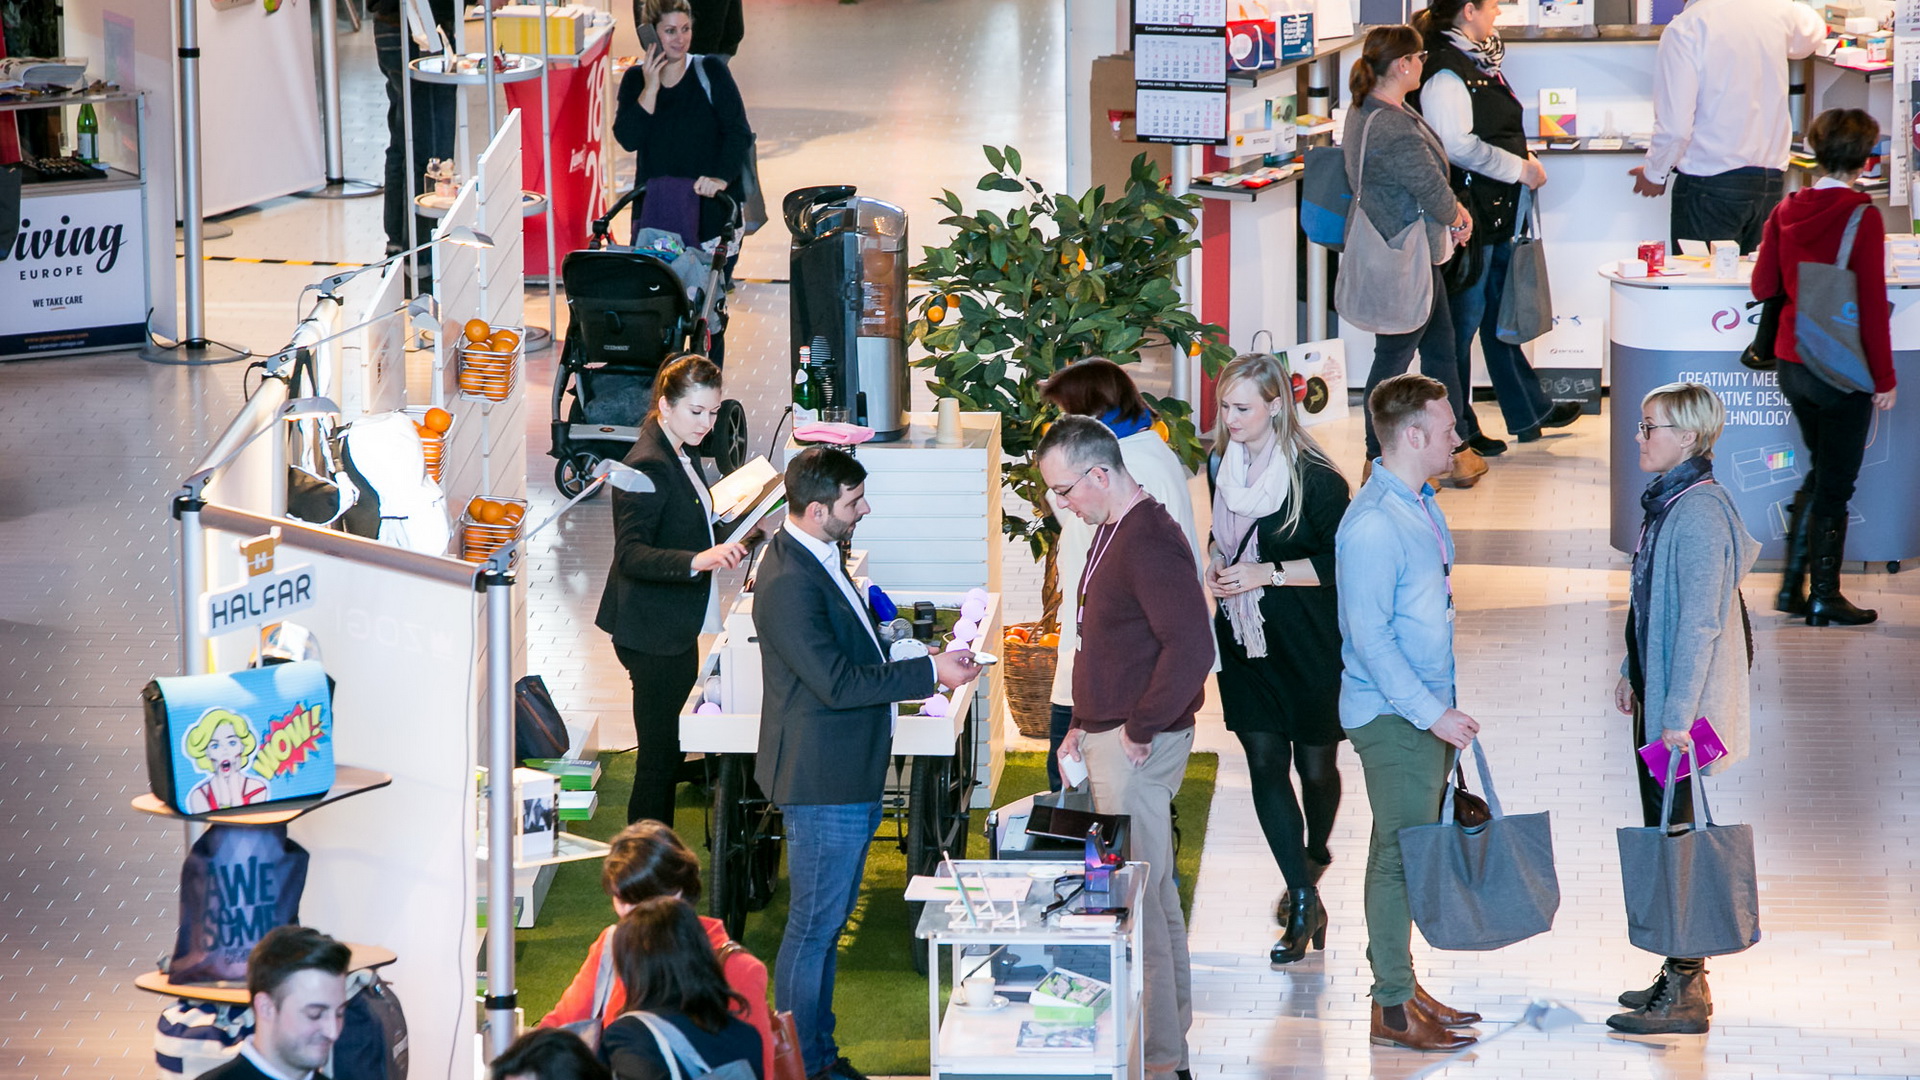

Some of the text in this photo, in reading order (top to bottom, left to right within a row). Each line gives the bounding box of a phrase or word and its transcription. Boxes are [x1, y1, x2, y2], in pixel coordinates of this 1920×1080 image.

[13, 215, 128, 273] iving
[20, 266, 84, 280] EUROPE
[33, 295, 83, 308] WE TAKE CARE
[1678, 372, 1780, 387] CREATIVITY MEE
[1724, 411, 1792, 426] CHNOLOGY
[212, 574, 311, 629] HALFAR
[252, 704, 322, 781] WOW!
[206, 856, 276, 908] AWE
